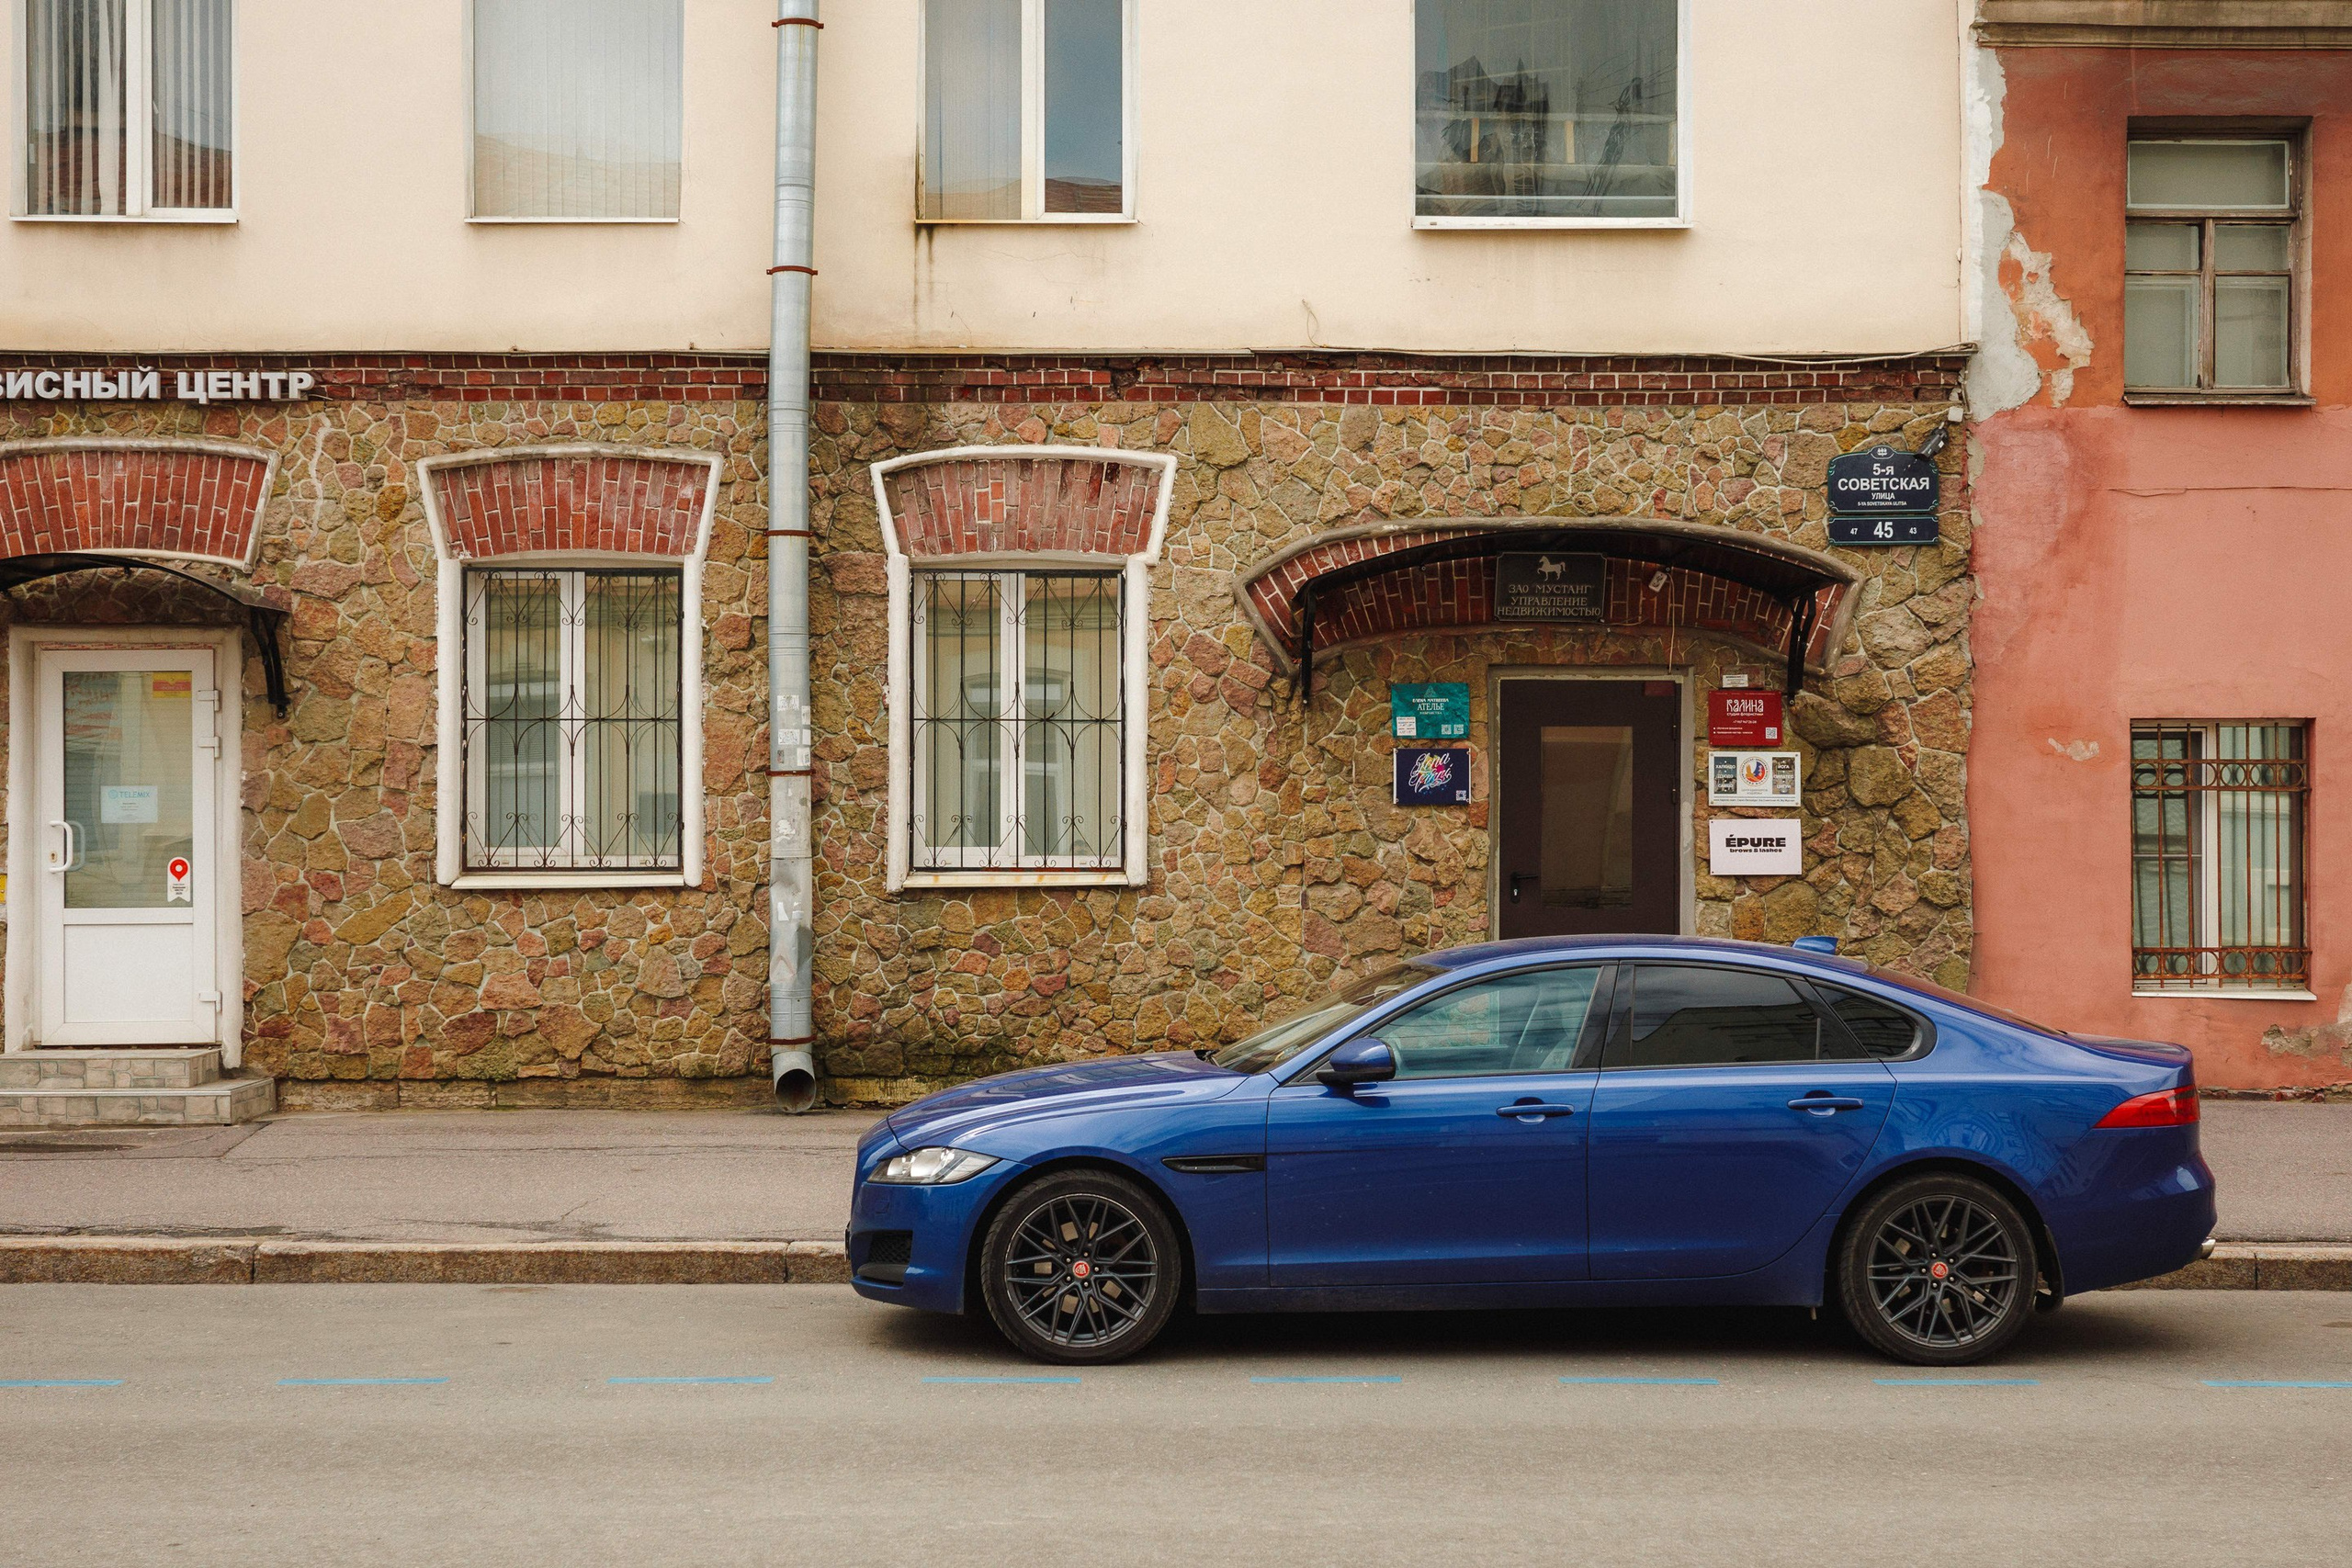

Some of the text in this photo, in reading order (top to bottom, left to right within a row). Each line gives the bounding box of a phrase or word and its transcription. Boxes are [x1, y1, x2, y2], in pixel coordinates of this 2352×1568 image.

[176, 371, 313, 405] ЦЕНТР
[1872, 463, 1894, 476] 5-я
[1838, 477, 1930, 491] СОВЕТСКАЯ
[1871, 492, 1895, 501] УЛИЦА
[1849, 527, 1859, 536] 47
[1873, 521, 1894, 538] 45
[1509, 584, 1529, 593] ЗАО
[1510, 596, 1588, 606] УПРАВЛЕНИЕ
[1497, 606, 1601, 617] НЕДВИЖИМОСТЬЮ
[1417, 703, 1445, 711] АТЕЛЬЕ
[1725, 834, 1786, 848] ÉPURE
